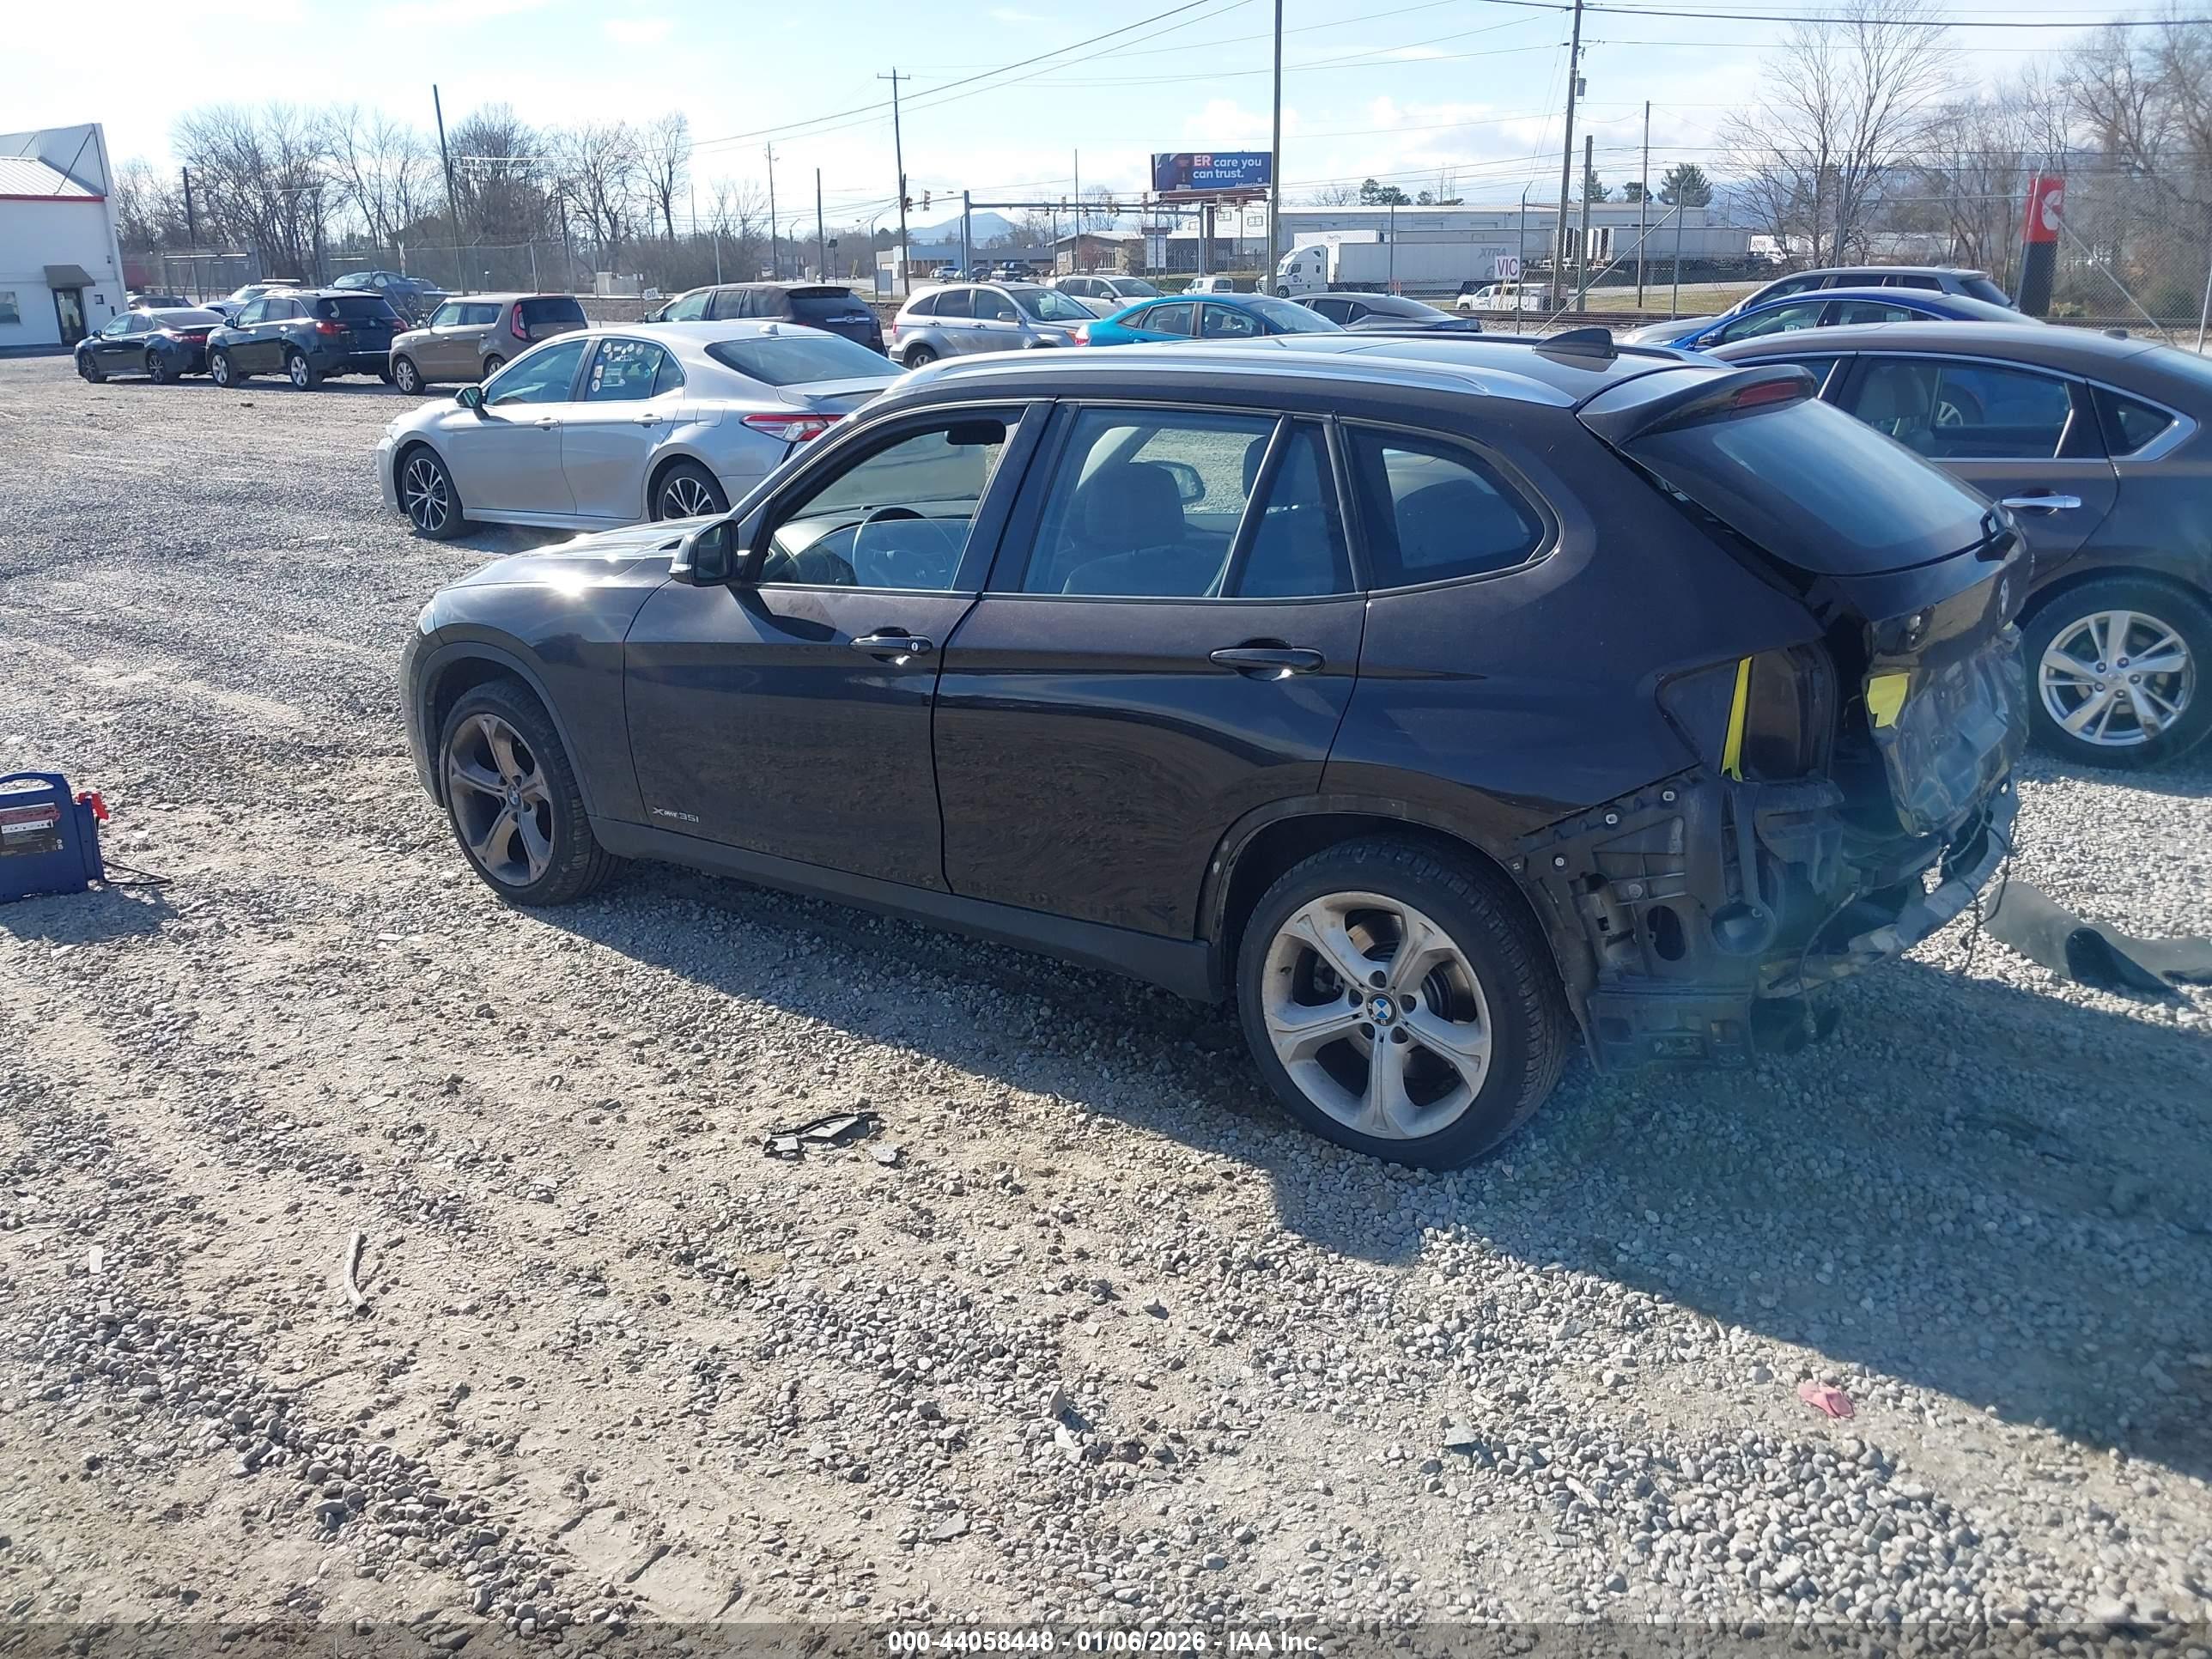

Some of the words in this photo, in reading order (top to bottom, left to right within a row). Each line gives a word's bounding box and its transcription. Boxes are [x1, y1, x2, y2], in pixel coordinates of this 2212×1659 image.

[1194, 155, 1211, 167] ER
[1241, 159, 1262, 169] you
[1193, 170, 1212, 179] can
[1215, 168, 1244, 179] trust.
[1497, 258, 1518, 276] VIC
